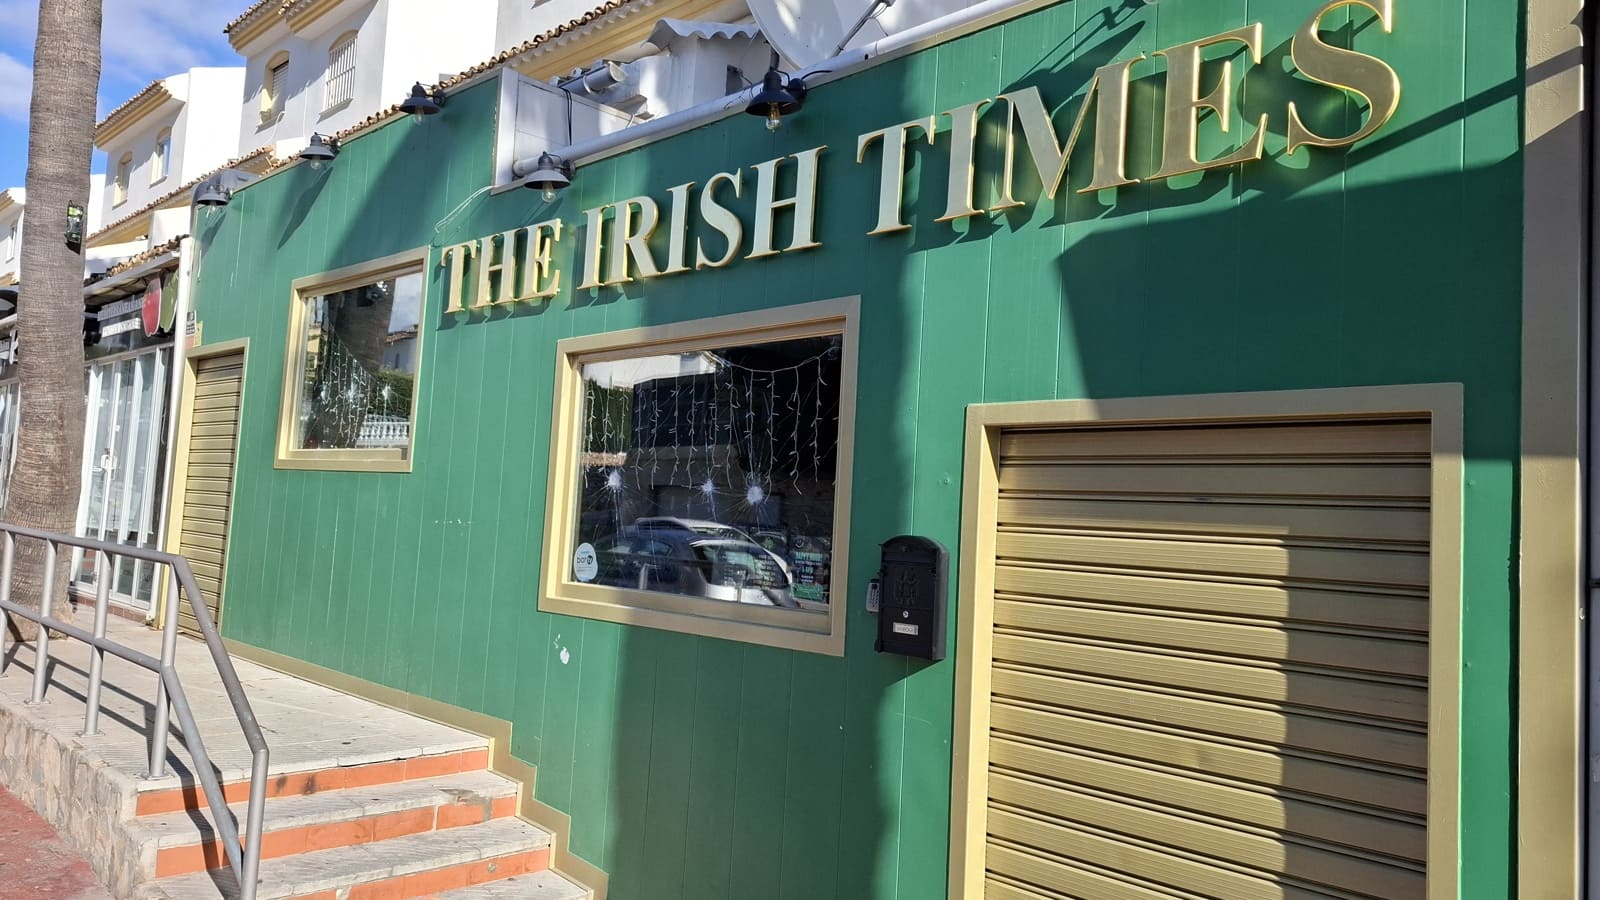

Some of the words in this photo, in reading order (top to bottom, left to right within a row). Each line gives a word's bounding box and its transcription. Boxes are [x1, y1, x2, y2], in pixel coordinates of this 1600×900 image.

[441, 218, 563, 314] THE
[577, 145, 828, 290] IRISH
[856, 0, 1401, 236] TIMES
